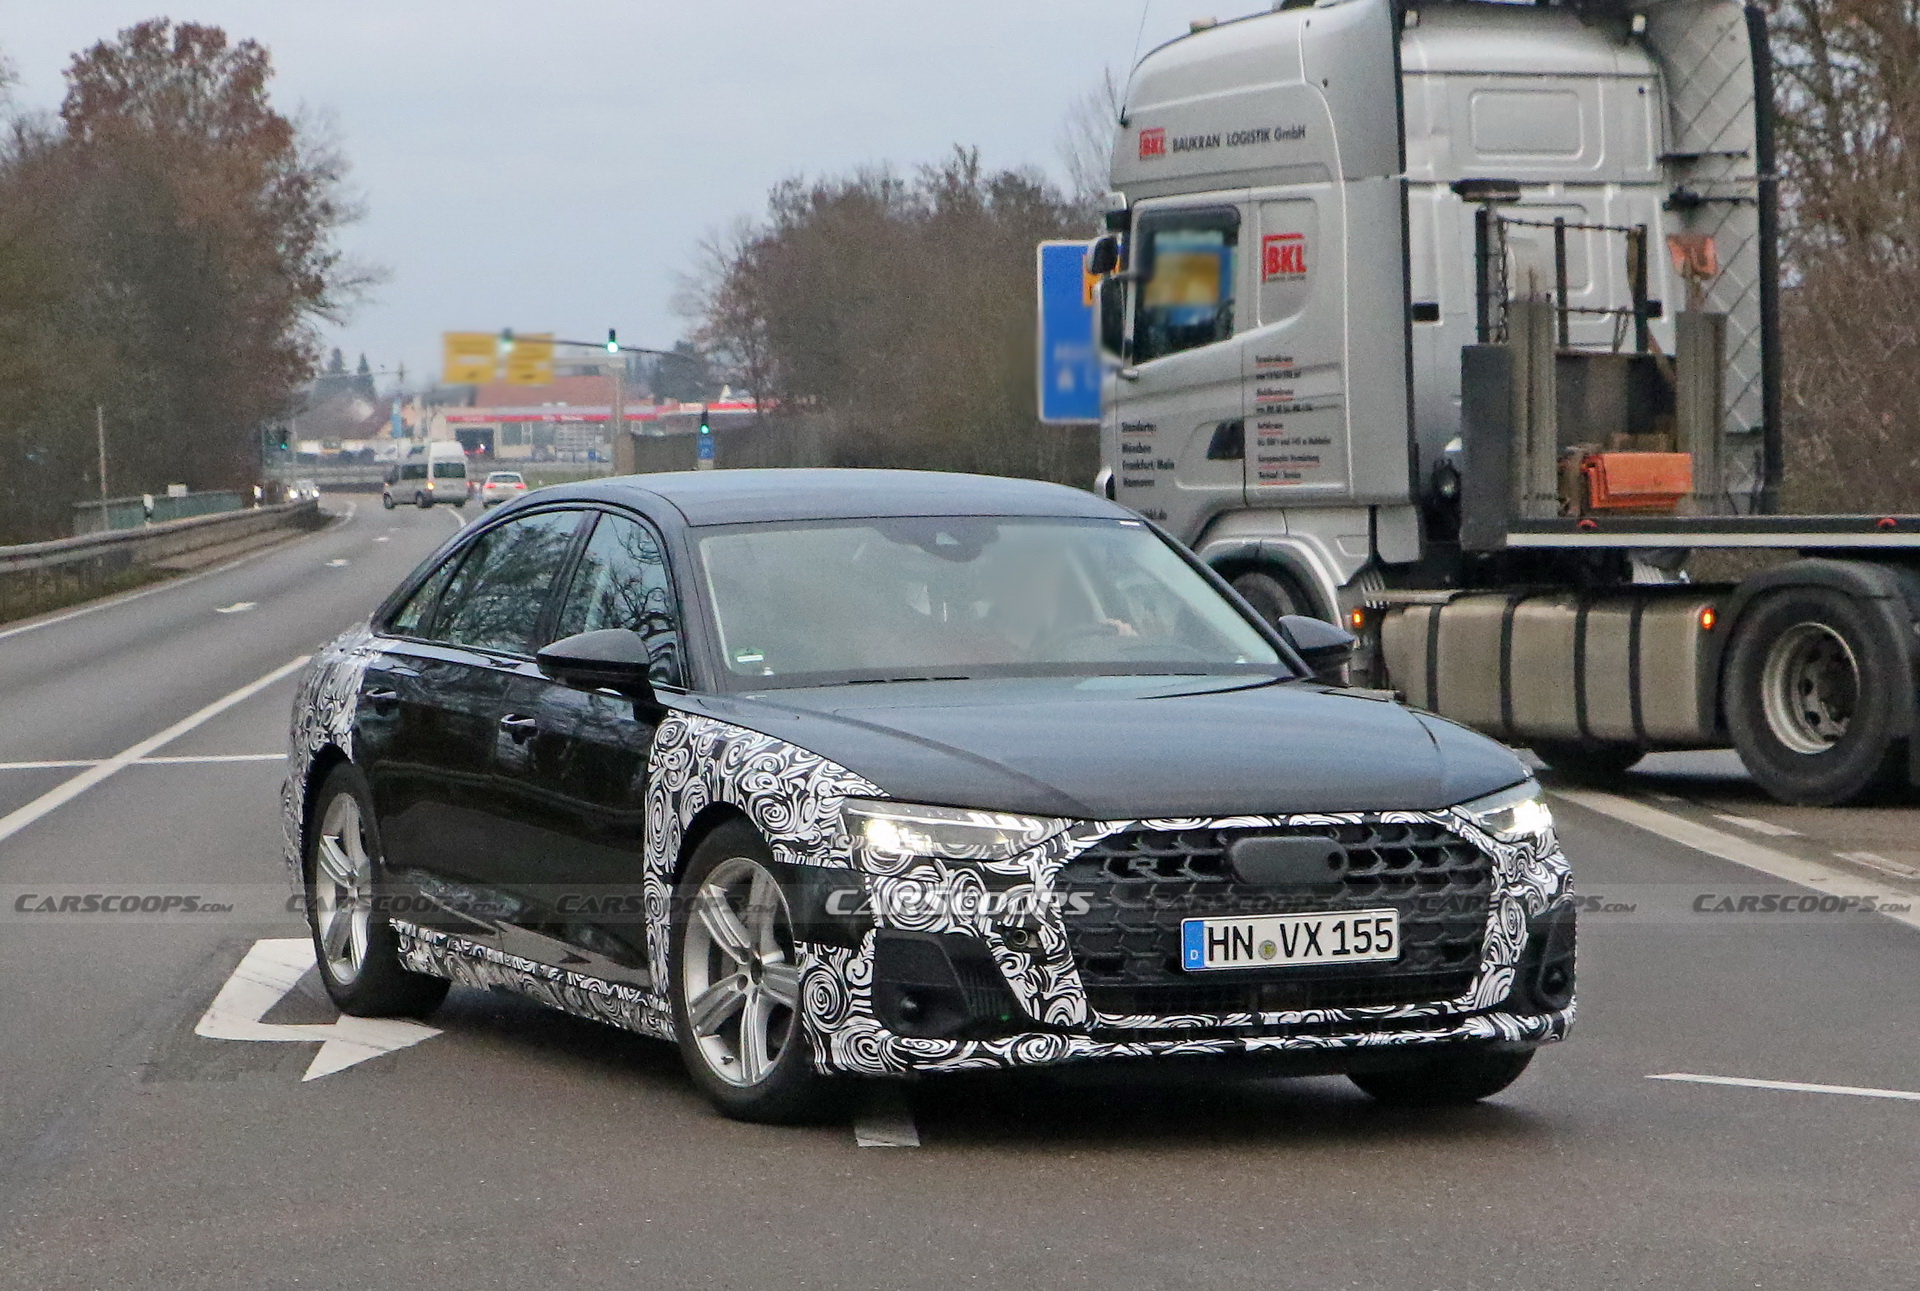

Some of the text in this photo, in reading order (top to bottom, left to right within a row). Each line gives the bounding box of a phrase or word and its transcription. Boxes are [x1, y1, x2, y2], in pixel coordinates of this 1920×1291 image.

[1173, 136, 1221, 152] BAUKRAN
[1226, 128, 1271, 147] LOGISTIK
[1274, 124, 1306, 142] GmbH
[1268, 245, 1307, 274] BKL
[1208, 925, 1254, 962] HN
[1280, 921, 1323, 958] VX
[1332, 917, 1394, 956] 155
